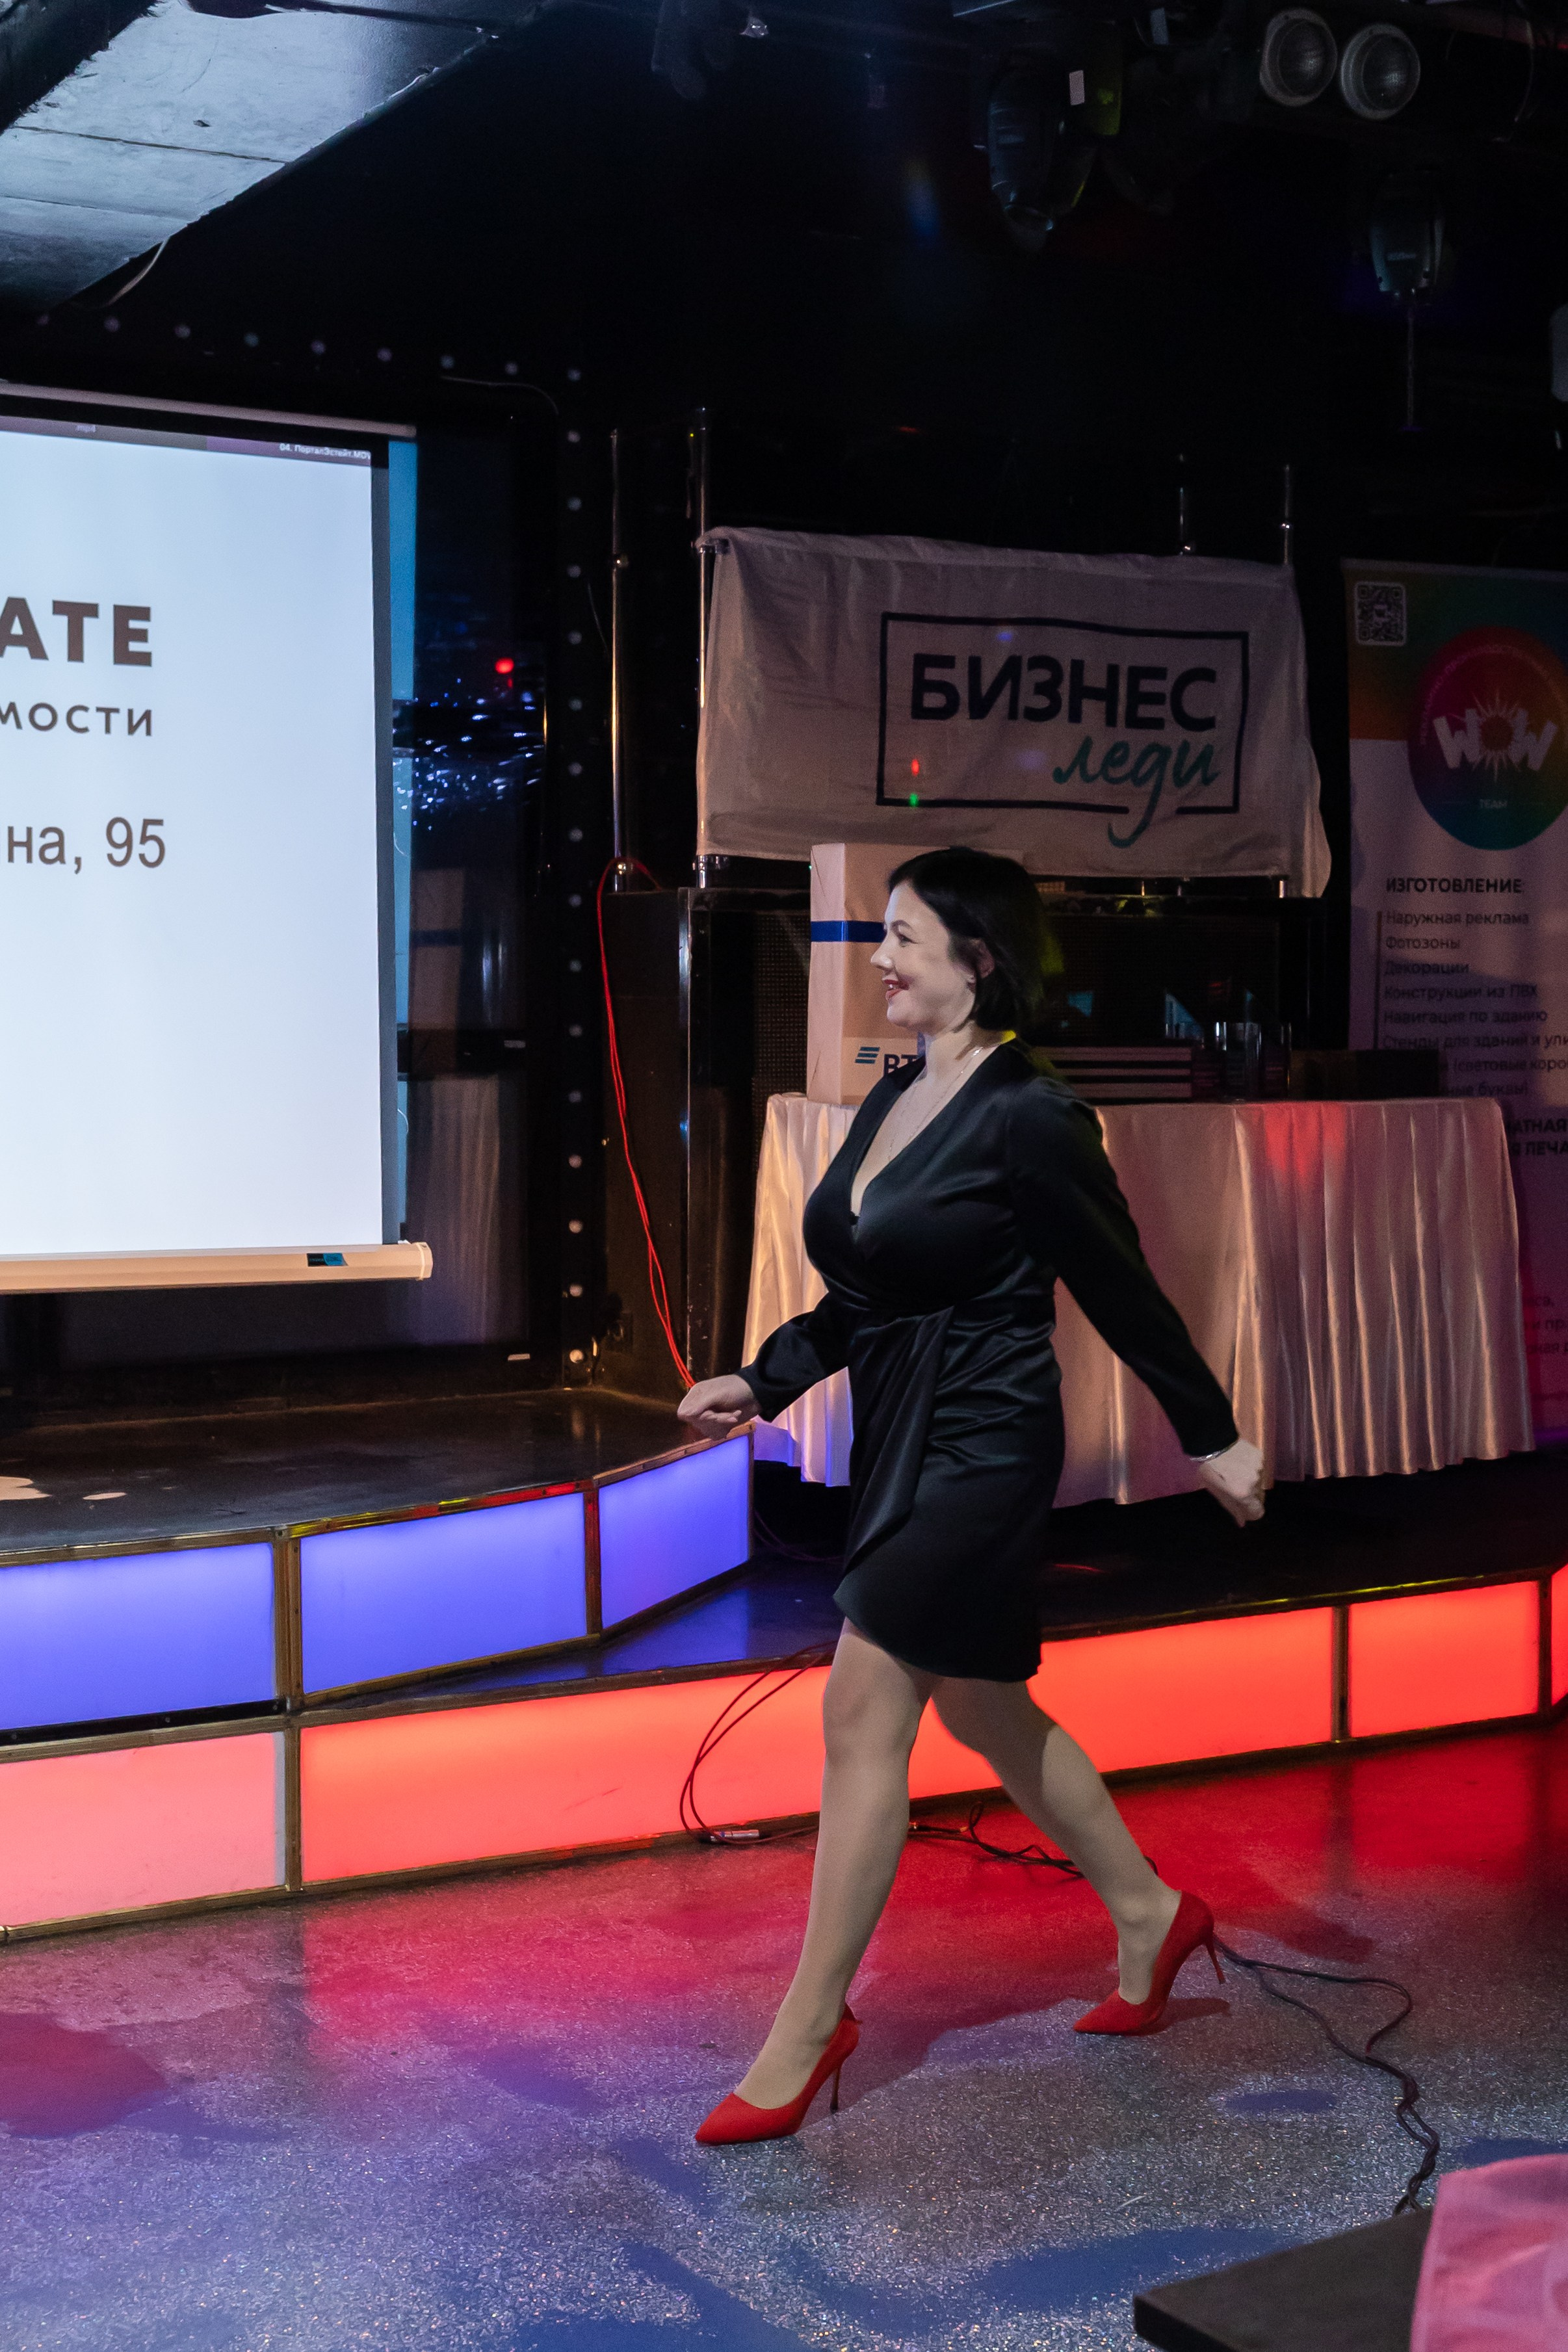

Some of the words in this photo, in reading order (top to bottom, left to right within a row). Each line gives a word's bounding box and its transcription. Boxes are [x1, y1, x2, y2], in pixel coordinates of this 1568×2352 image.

[910, 653, 1217, 731] БИЗНЕС
[1052, 735, 1221, 848] леди
[106, 817, 166, 868] 95
[1386, 911, 1462, 926] Наружная
[1465, 913, 1529, 926] реклама
[1385, 937, 1461, 949] Фотозоны
[1383, 961, 1469, 975] Декорации
[1384, 986, 1482, 1001] Конструкции
[1486, 986, 1506, 998] из
[1510, 984, 1537, 998] ПВХ
[1383, 1012, 1465, 1024] Навигация
[1469, 1012, 1487, 1022] по
